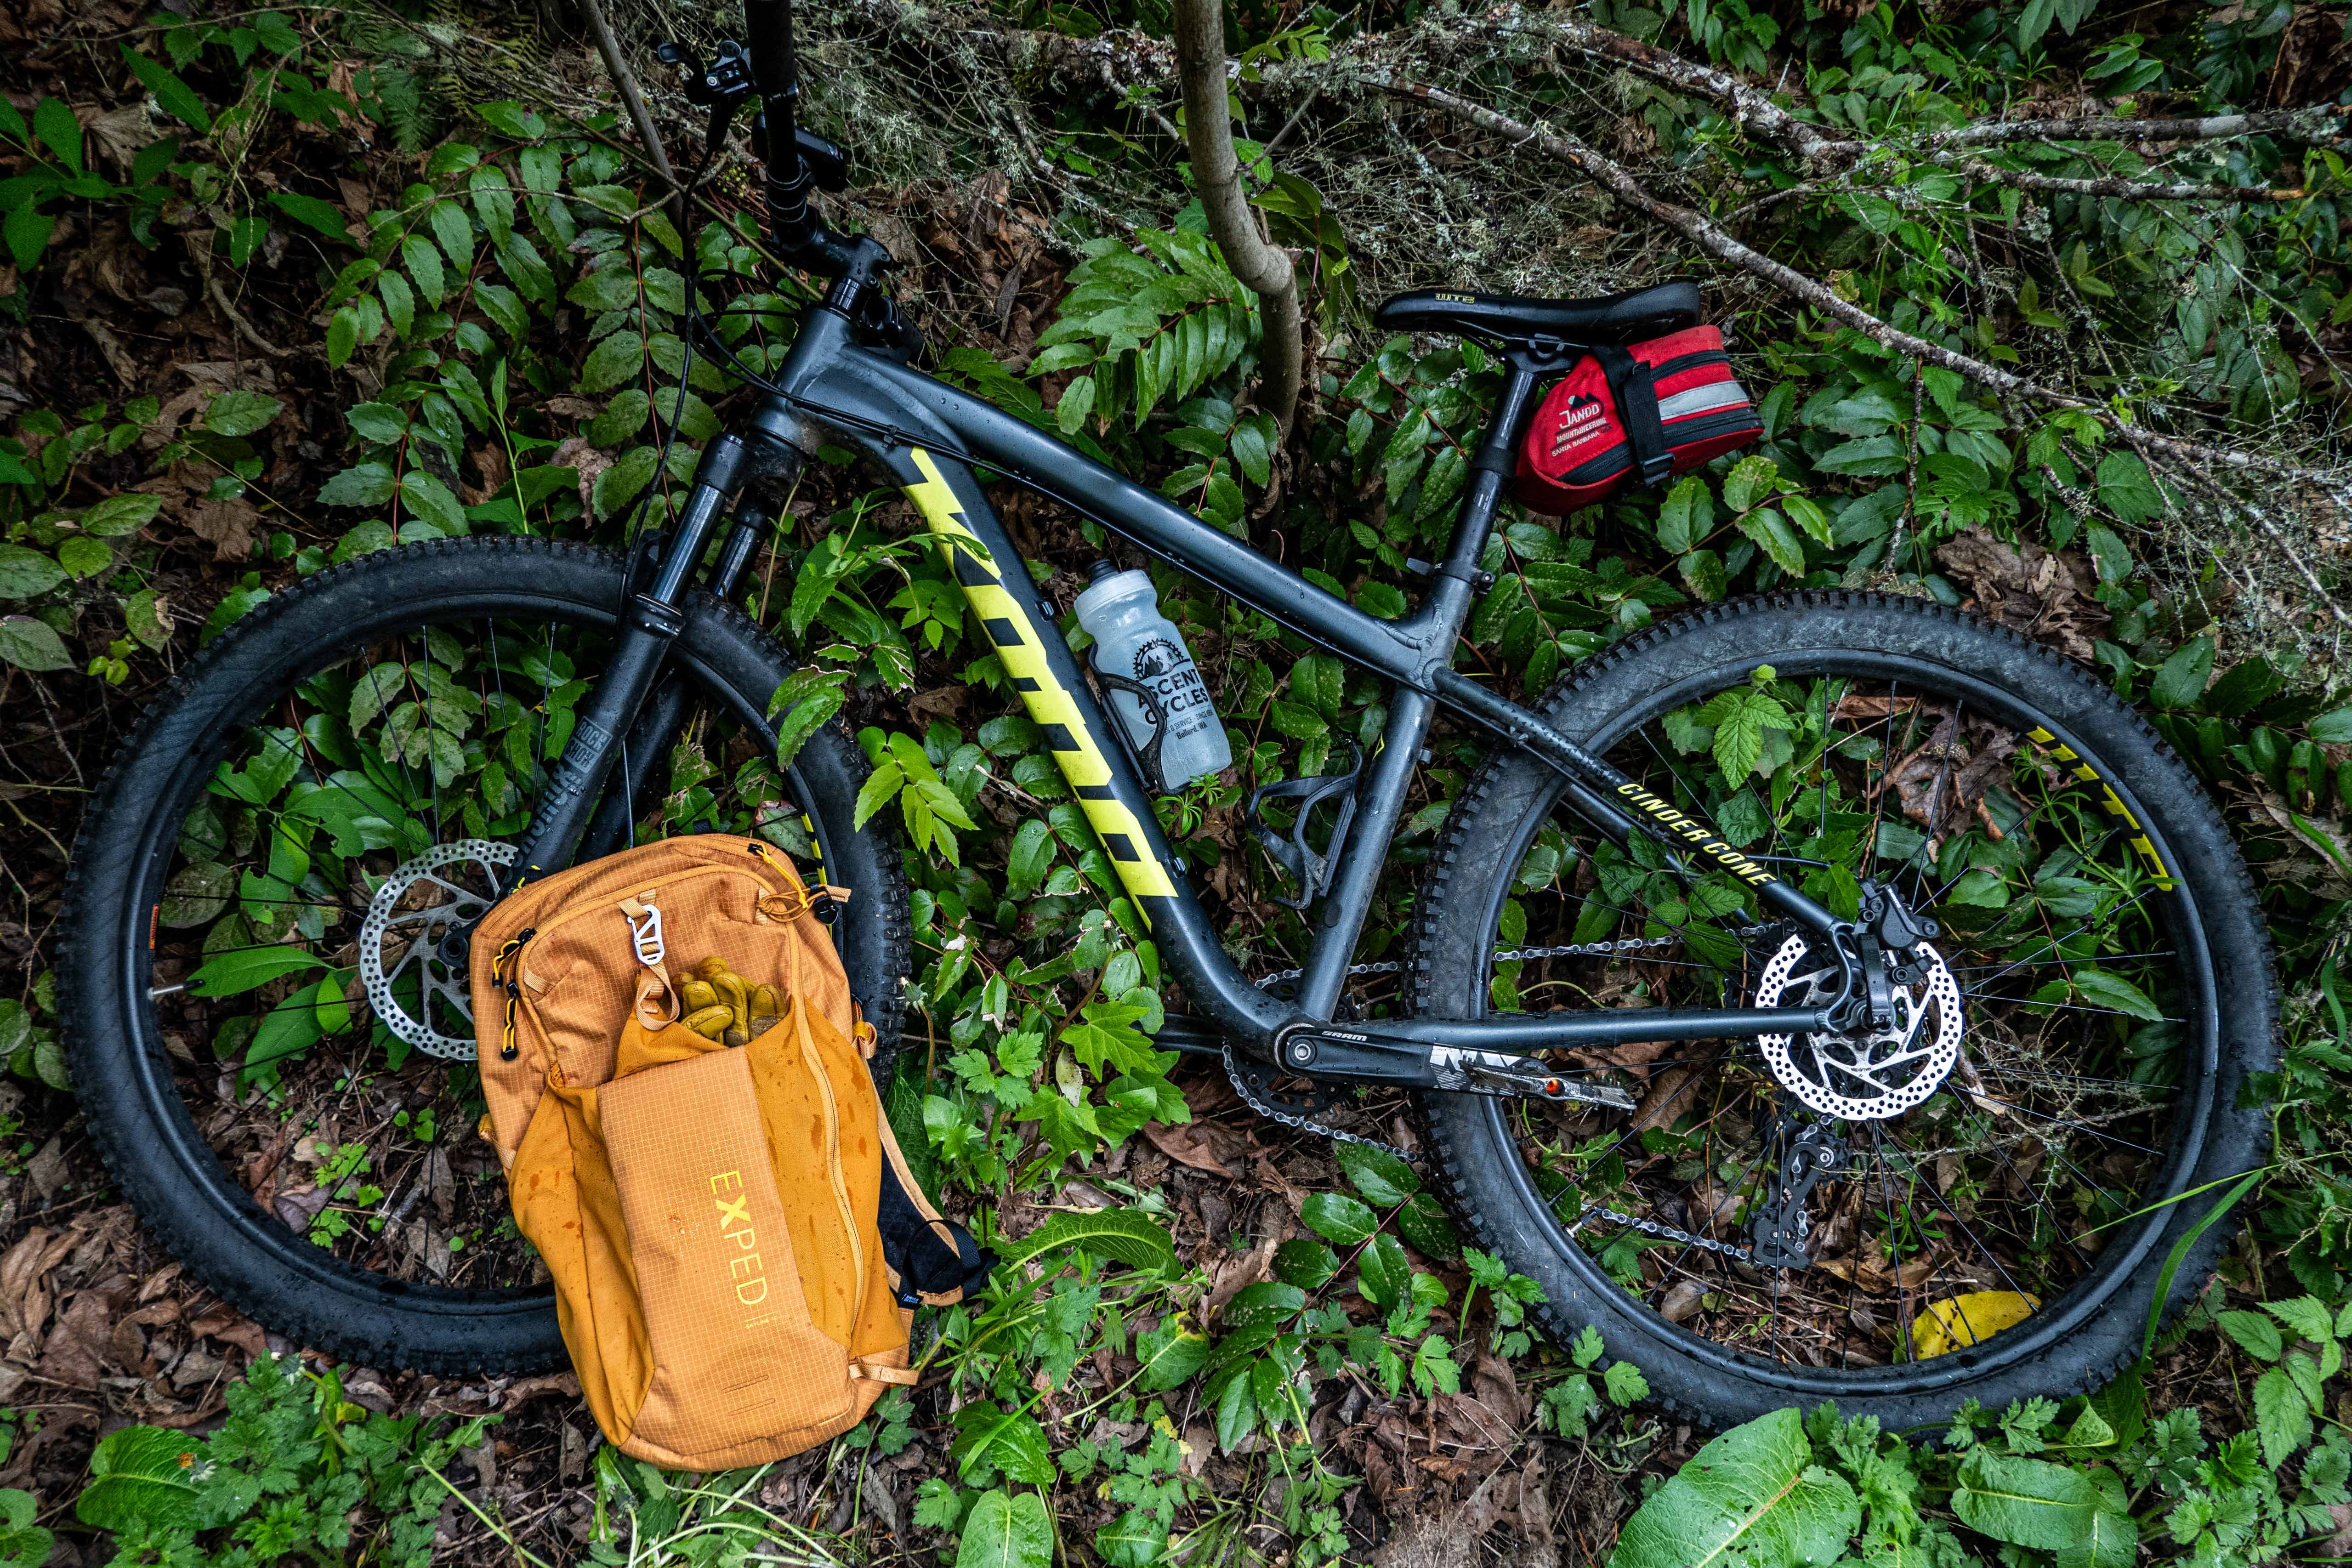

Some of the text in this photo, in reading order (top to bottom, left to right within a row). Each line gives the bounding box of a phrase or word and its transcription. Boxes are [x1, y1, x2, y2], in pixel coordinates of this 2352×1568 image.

[1435, 293, 1475, 304] WTB
[1559, 404, 1599, 429] JANDD
[1557, 417, 1607, 444] MOUNTAINEERING
[1551, 431, 1600, 457] SANTA BARBARA
[1174, 716, 1193, 729] SERVICE
[1176, 725, 1199, 739] Ballard,
[1198, 721, 1208, 730] WA
[1617, 783, 1777, 886] CINDER CONE
[1322, 1031, 1367, 1042] SRAM
[710, 1170, 768, 1305] EXPED
